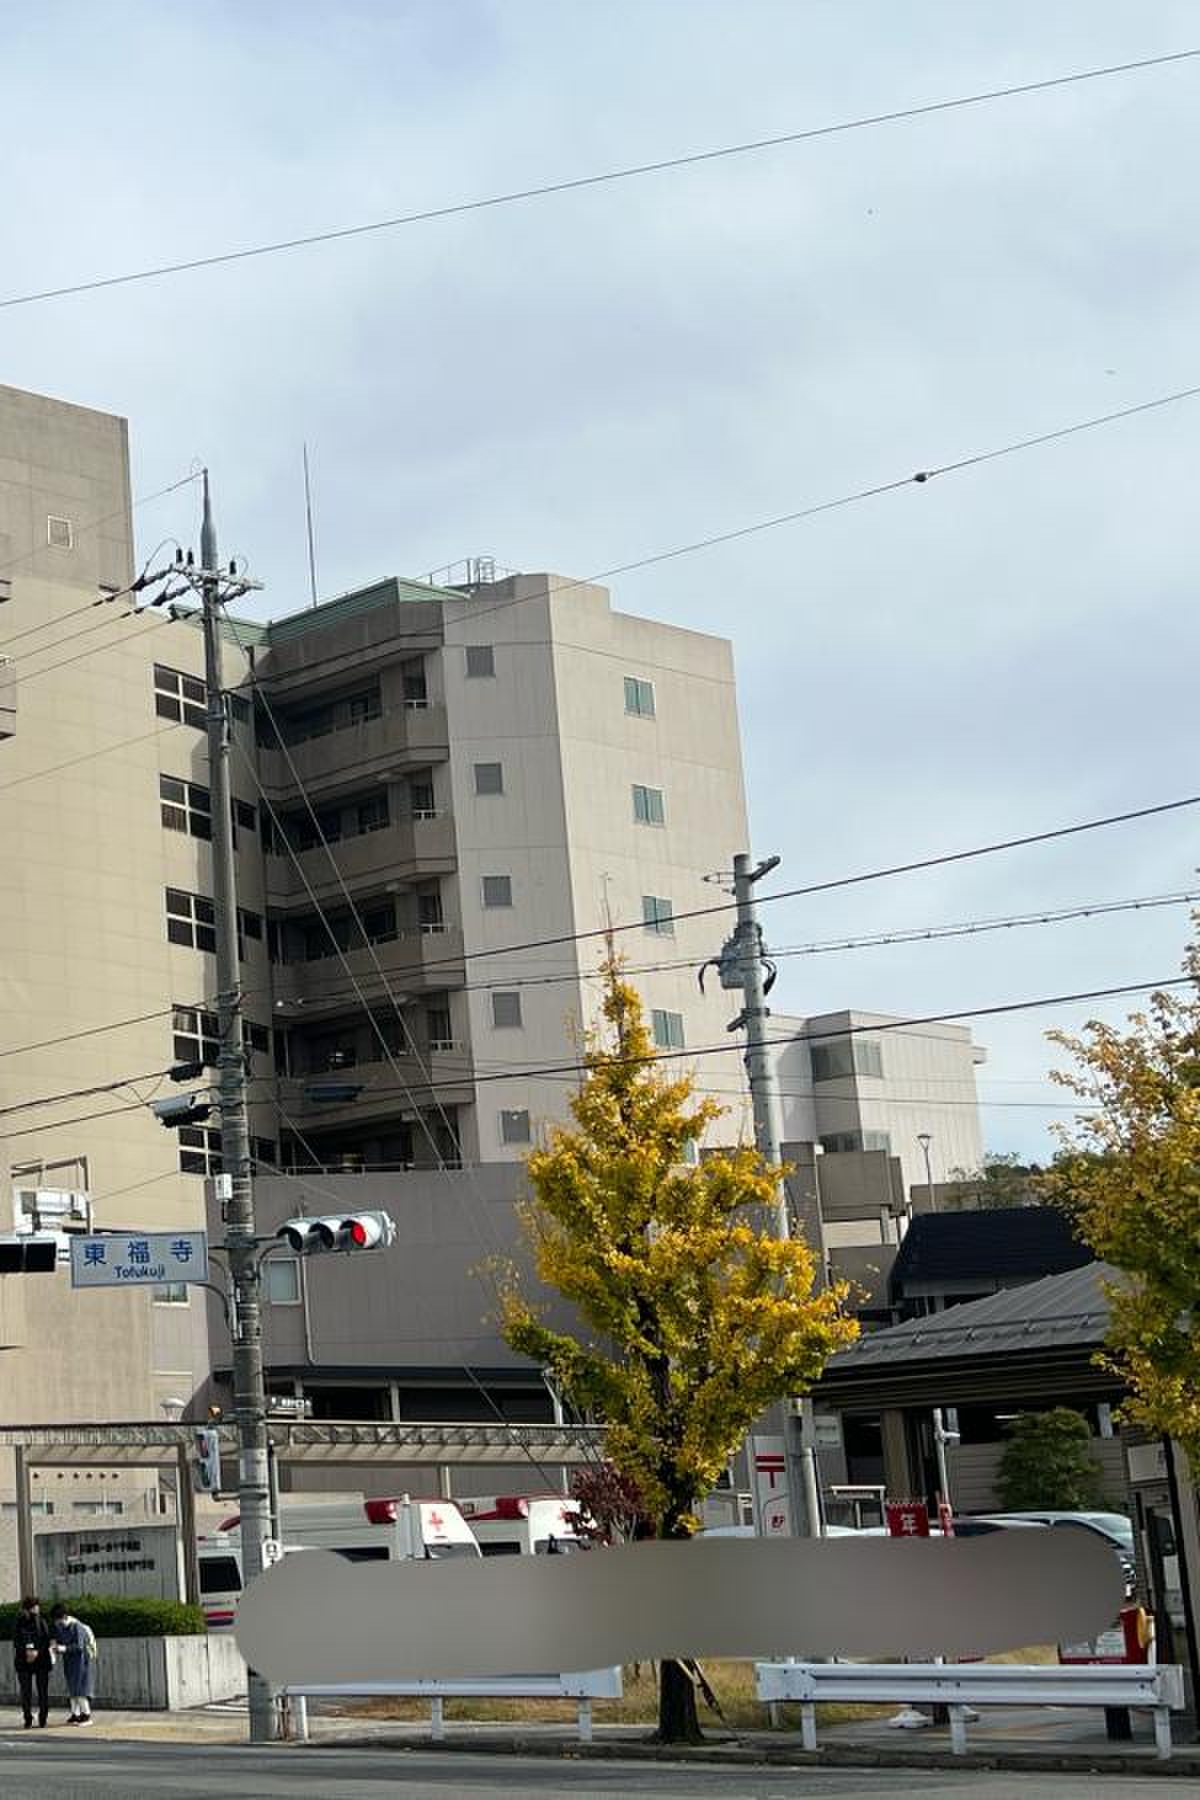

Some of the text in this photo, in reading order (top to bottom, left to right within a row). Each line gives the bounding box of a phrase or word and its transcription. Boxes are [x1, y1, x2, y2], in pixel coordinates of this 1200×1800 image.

[83, 1240, 192, 1266] 東福寺
[113, 1264, 165, 1279] Tofukuji
